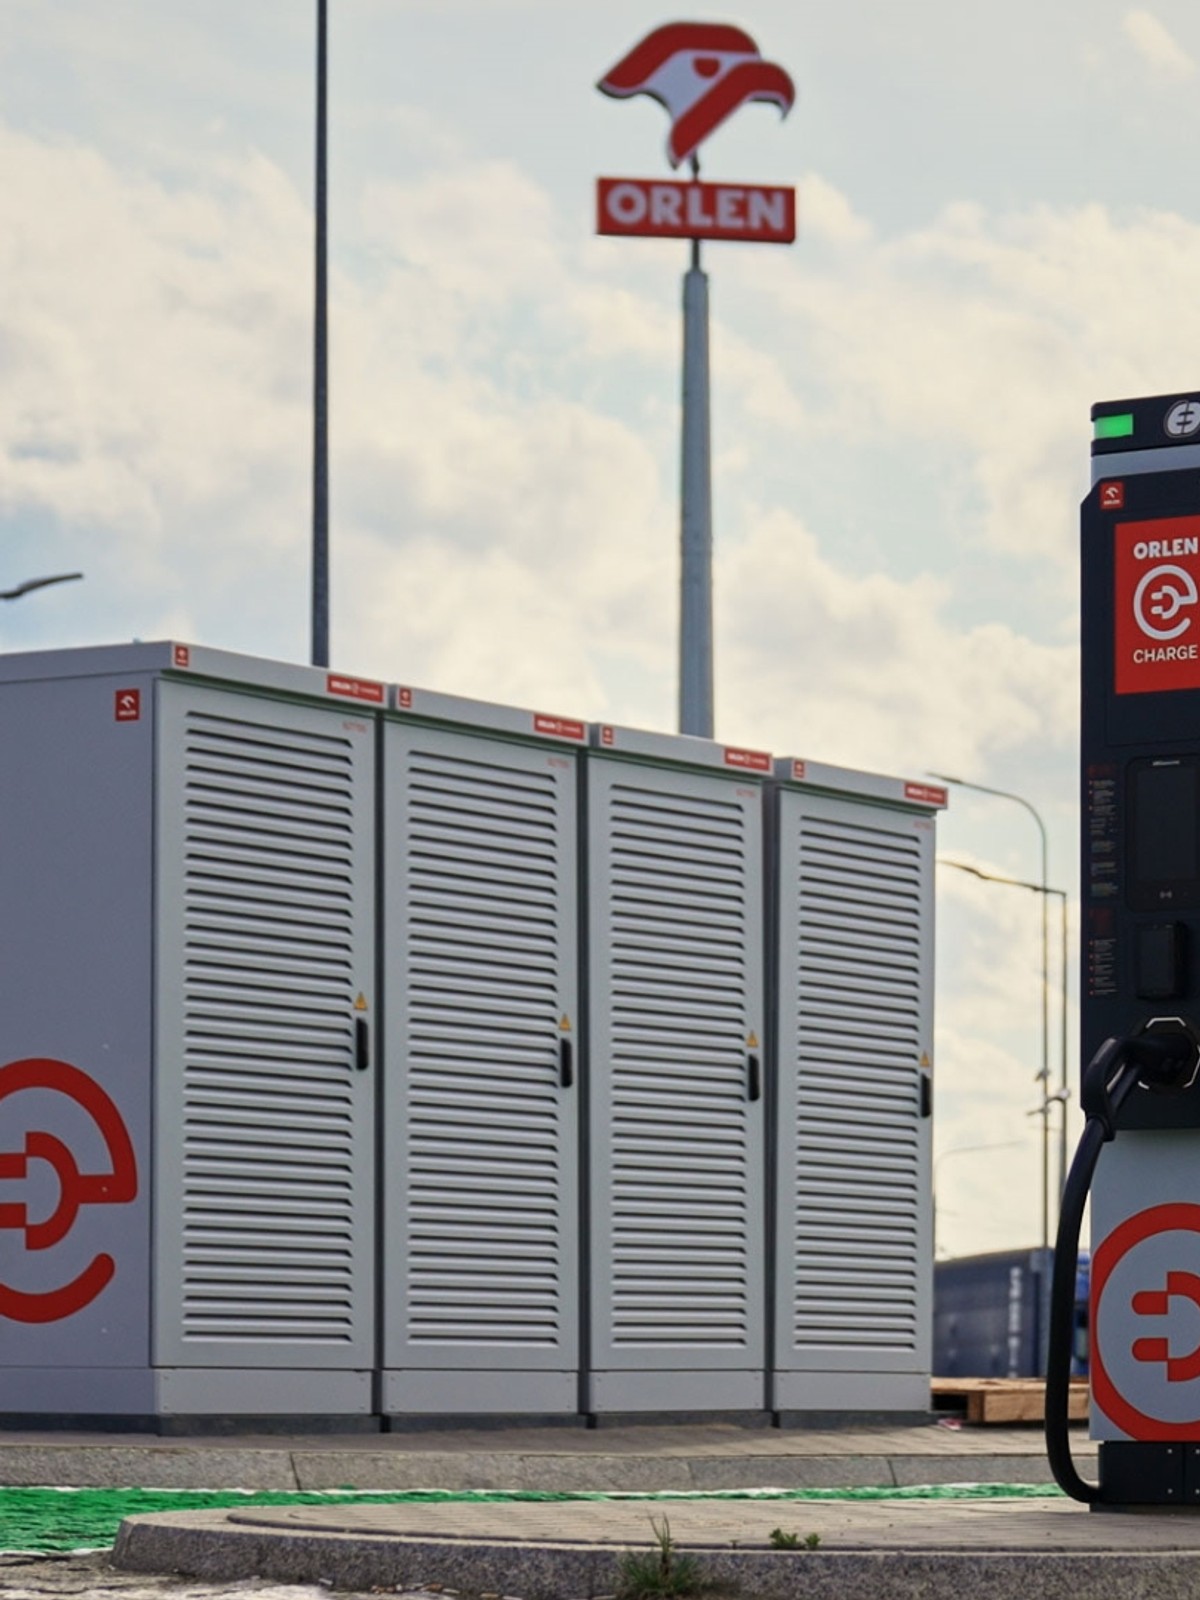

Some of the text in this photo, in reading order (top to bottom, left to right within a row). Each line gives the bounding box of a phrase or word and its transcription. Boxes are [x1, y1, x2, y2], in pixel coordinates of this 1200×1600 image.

[606, 183, 786, 230] ORLEN
[1133, 536, 1199, 560] ORLEN
[1133, 644, 1199, 664] CHARGE
